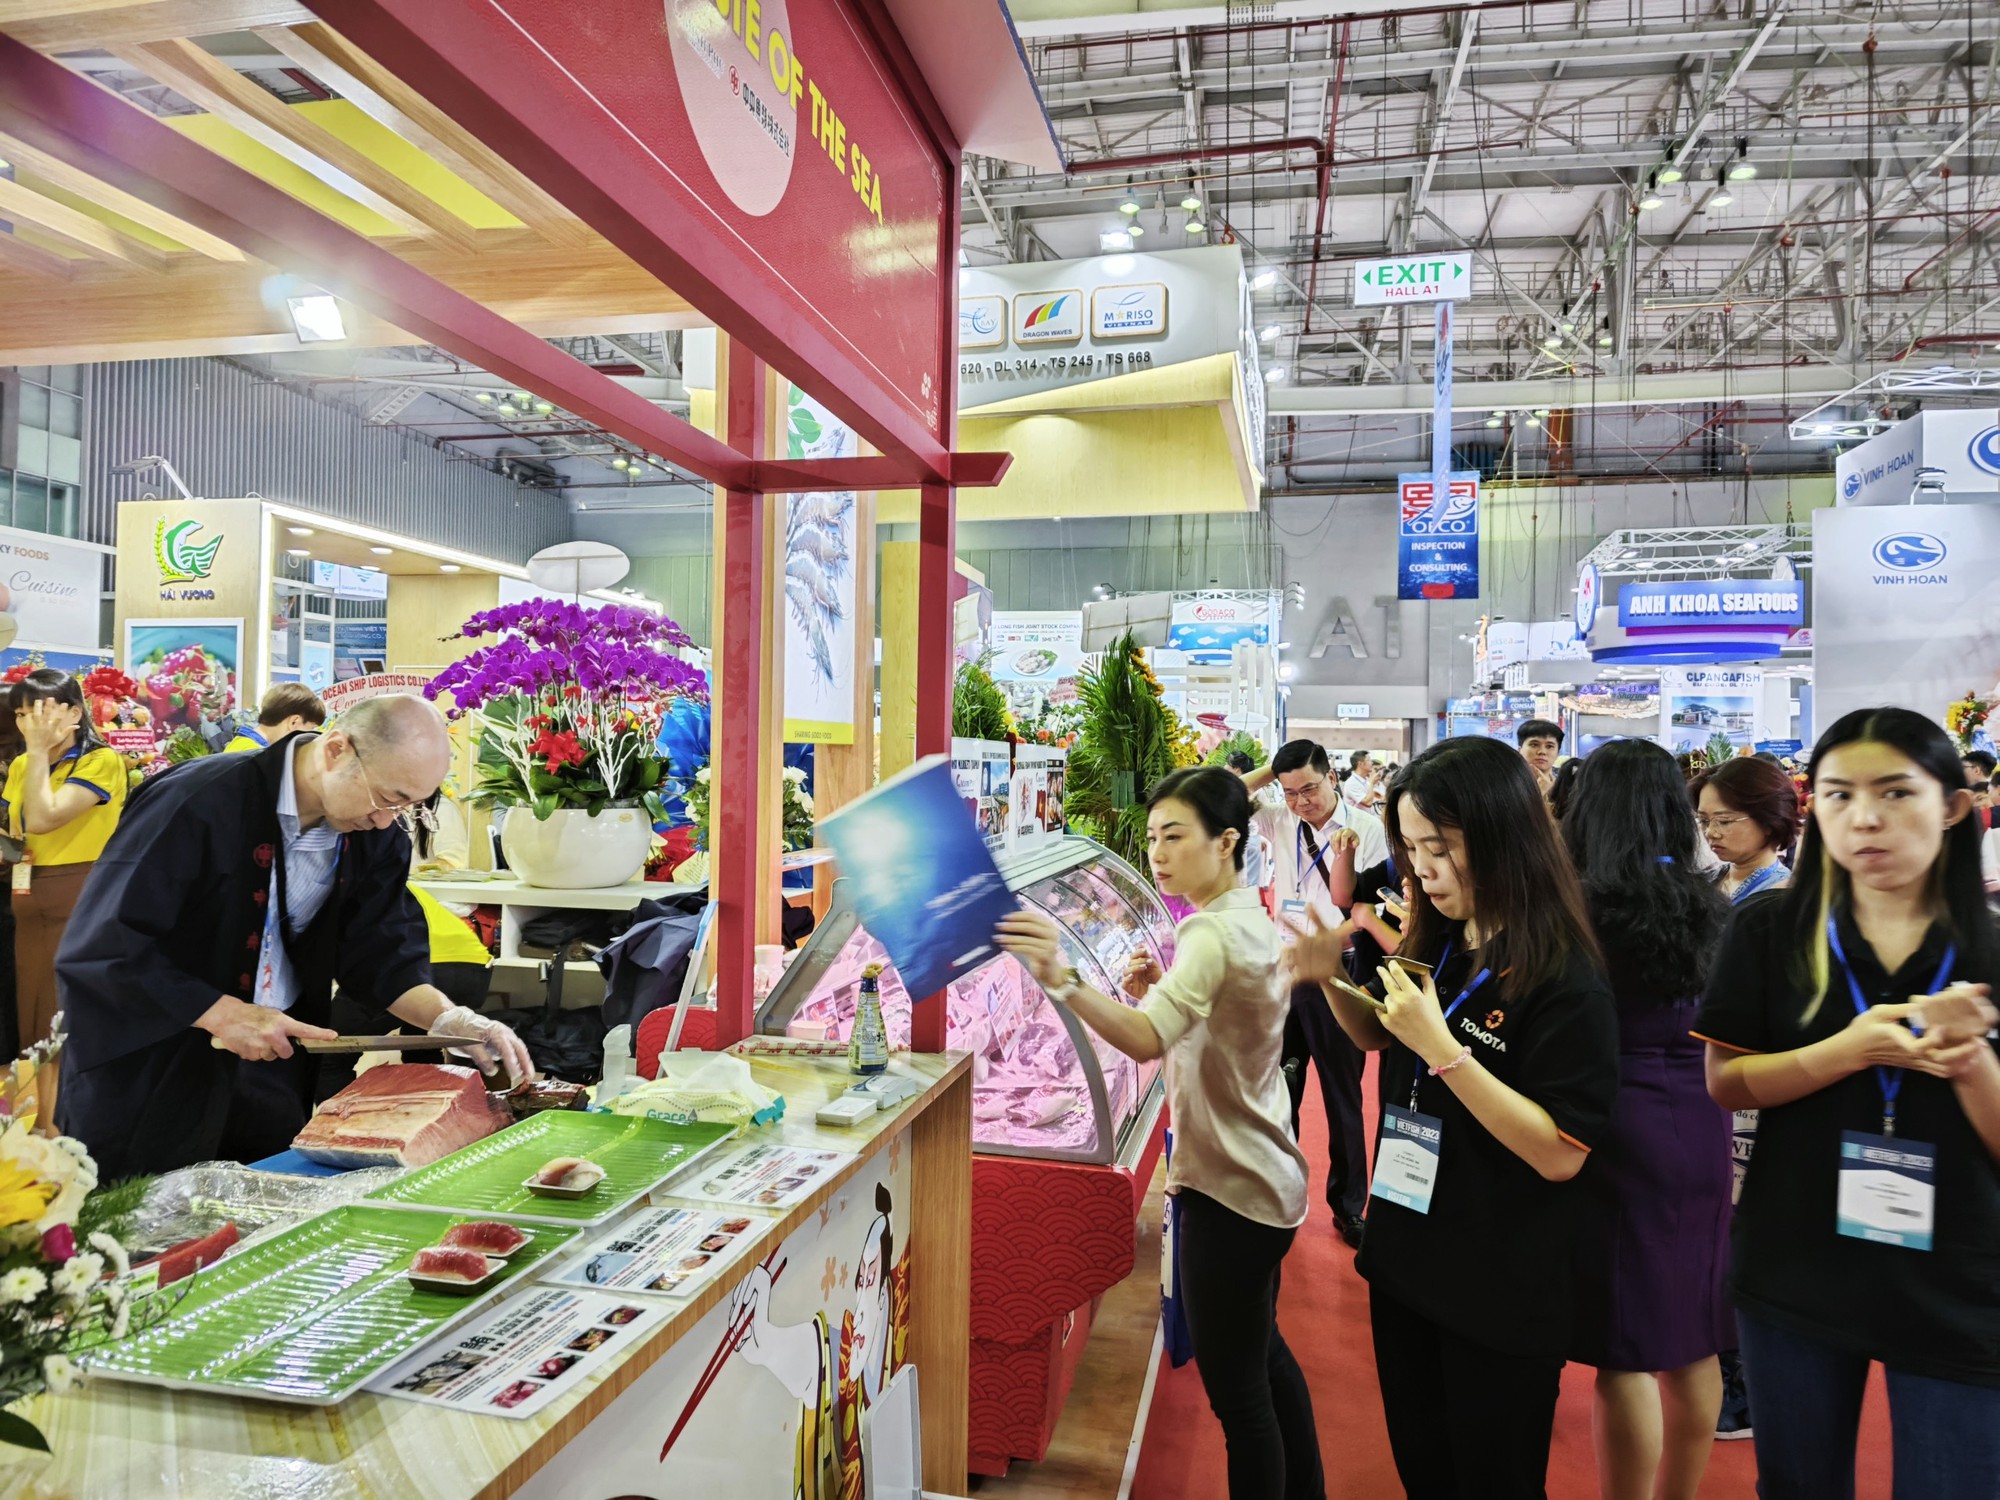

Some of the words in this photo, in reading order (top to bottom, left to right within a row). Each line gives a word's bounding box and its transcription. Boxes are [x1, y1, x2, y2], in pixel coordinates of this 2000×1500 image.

[769, 28, 803, 112] OF
[809, 78, 846, 176] THE
[851, 142, 883, 225] SEA
[1378, 262, 1446, 285] EXIT
[1385, 286, 1419, 297] HALL
[1423, 285, 1439, 295] A1
[1106, 320, 1152, 328] VIETNAM
[1022, 331, 1049, 339] DRAGON
[1051, 329, 1072, 337] WAVES
[960, 363, 982, 376] 620
[994, 361, 1011, 372] DL
[1015, 359, 1037, 371] 314
[1050, 357, 1066, 368] TS
[1071, 354, 1094, 367] 245
[1106, 353, 1123, 365] TS
[1128, 351, 1151, 363] 668
[1863, 464, 1884, 485] VINH
[1887, 449, 1914, 474] HOAN
[14, 546, 50, 561] FOODS
[1411, 541, 1466, 551] INSPECTION
[1408, 562, 1468, 572] CONSULTING
[9, 570, 78, 597] Cuisine
[1873, 575, 1904, 585] VINH
[1908, 575, 1948, 585] HOAN
[1630, 595, 1666, 614] ANH
[1670, 593, 1720, 613] KHOA
[1723, 592, 1799, 613] SEAFOODS
[1686, 672, 1761, 682] CLPANGAFISH
[322, 682, 348, 701] OCEAN
[349, 677, 366, 692] SHIP
[369, 675, 405, 688] LOGISTICS
[1460, 1017, 1507, 1053] TOMOTA
[647, 1108, 687, 1120] Grace
[1397, 1118, 1420, 1135] VIETFISH
[1421, 1126, 1440, 1141] 2023
[1387, 1189, 1412, 1207] VISITOR
